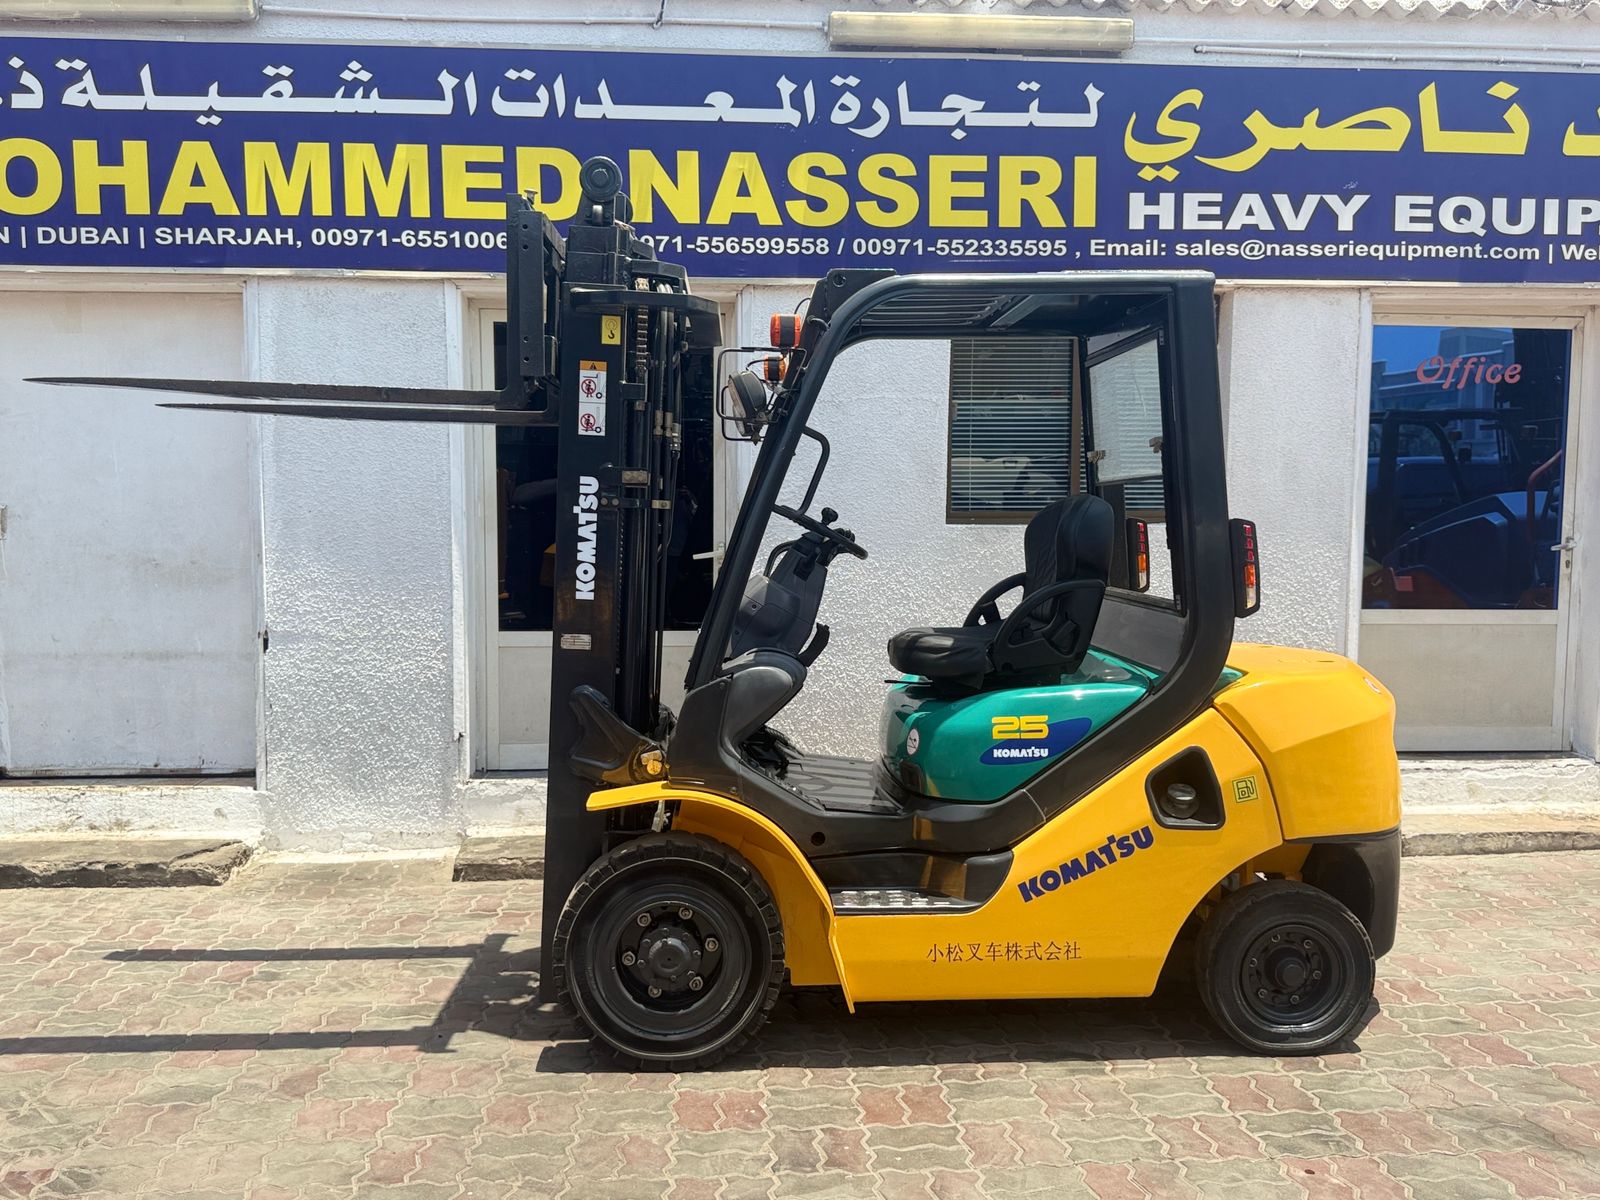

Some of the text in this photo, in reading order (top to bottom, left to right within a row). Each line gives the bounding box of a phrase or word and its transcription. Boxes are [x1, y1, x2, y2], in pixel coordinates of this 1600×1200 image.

[491, 68, 816, 128] المعدات
[830, 75, 1105, 140] لتجارة
[1124, 80, 1531, 182] ناصري
[628, 149, 1097, 229] NASSERI
[1128, 193, 1371, 232] HEAVY
[1394, 195, 1600, 237] EQUIP
[37, 226, 129, 245] DUBAI
[155, 227, 302, 249] SHARJAH,
[311, 228, 508, 250] 00971-6551006
[640, 235, 830, 255] 971-556599558
[852, 238, 1067, 257] 00971-552335595
[1090, 239, 1166, 256] Email:
[1175, 239, 1540, 261] sales@nasseriequipment.com
[1560, 244, 1600, 261] We
[1416, 355, 1522, 390] Office
[573, 475, 600, 600] KOMATSU
[991, 715, 1049, 740] 25
[993, 746, 1049, 758] KOMATSU
[1017, 825, 1155, 903] KOMATSU
[926, 941, 1083, 963] 小松叉车株式会社
